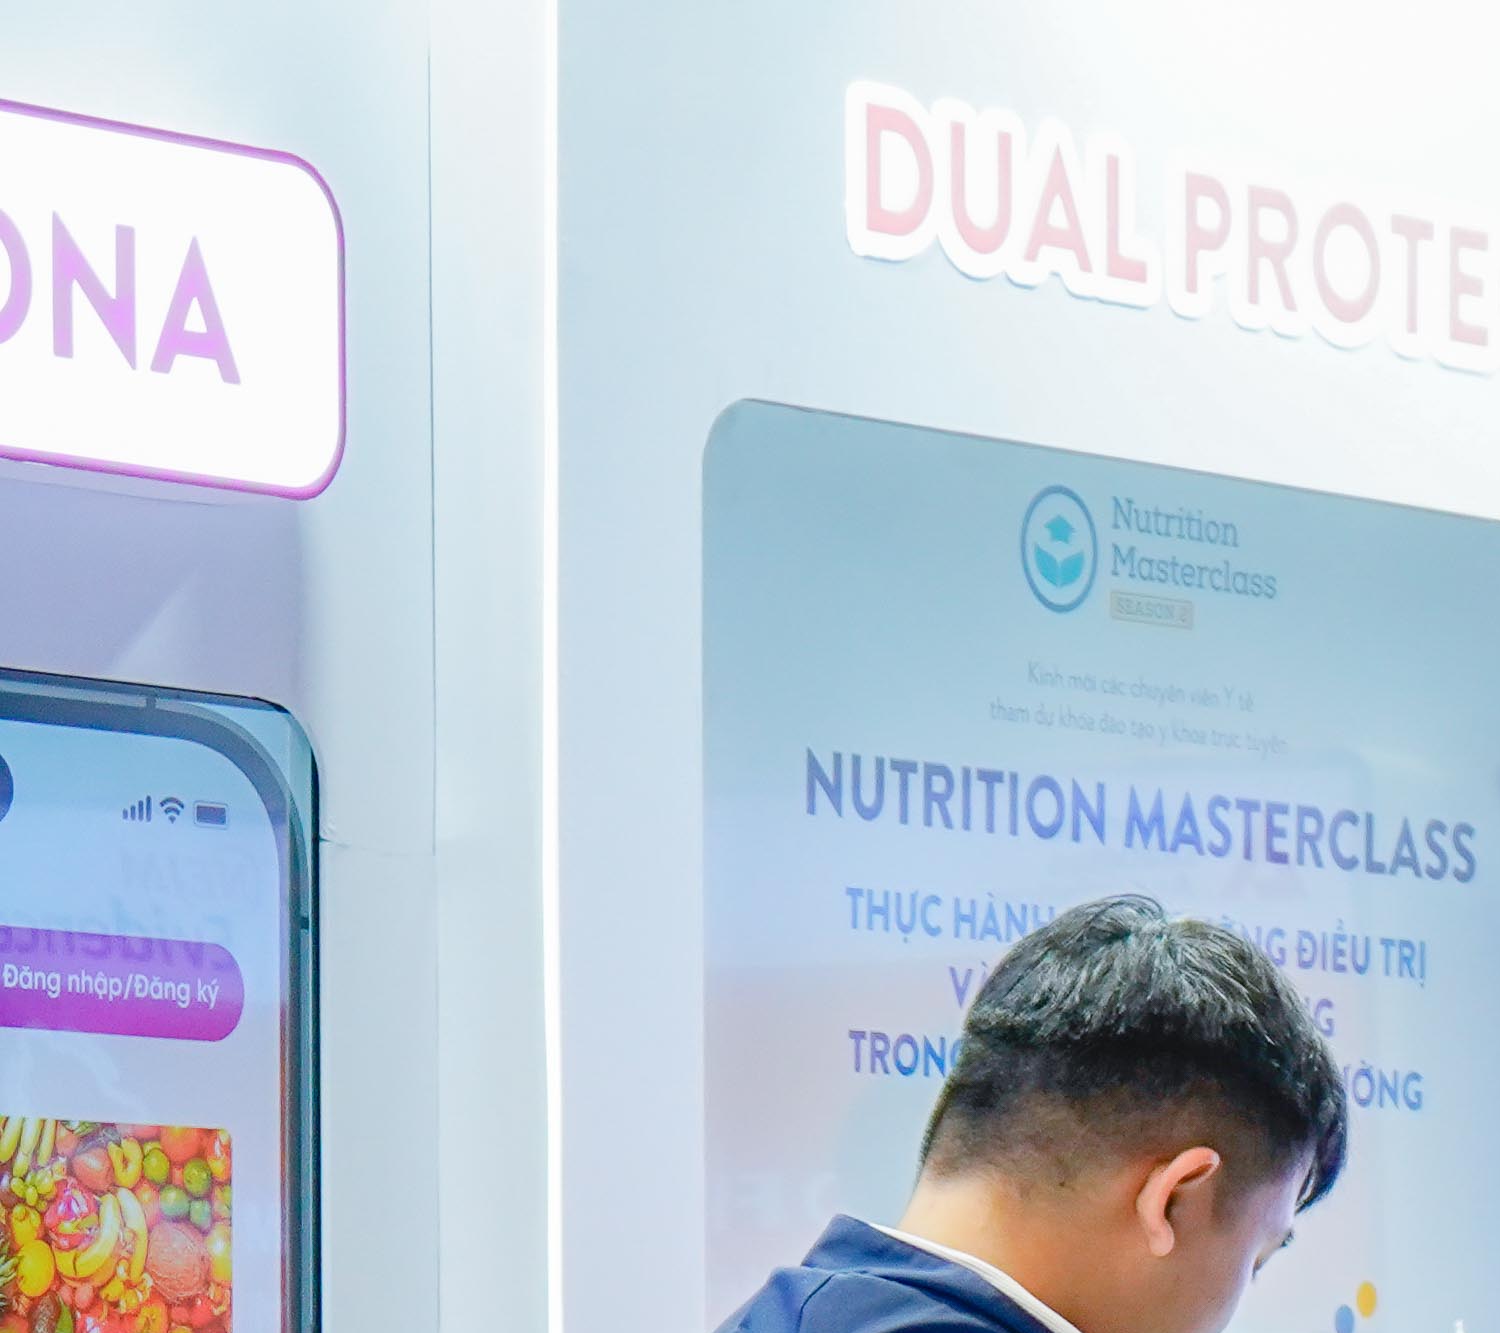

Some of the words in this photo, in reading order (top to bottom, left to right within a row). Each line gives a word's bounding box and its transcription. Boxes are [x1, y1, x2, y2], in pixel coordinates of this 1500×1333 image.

[865, 101, 1149, 285] DUAL
[1111, 495, 1241, 549] Nutrition
[1111, 542, 1279, 600] Masterclass
[805, 747, 1106, 846] NUTRITION
[1123, 784, 1478, 884] MASTERCLASS
[845, 886, 943, 944] THỰC
[1379, 937, 1427, 989] TRỊ
[2, 963, 62, 999] Đăng
[67, 969, 192, 1009] nhập/Đăng
[196, 977, 221, 1010] ký
